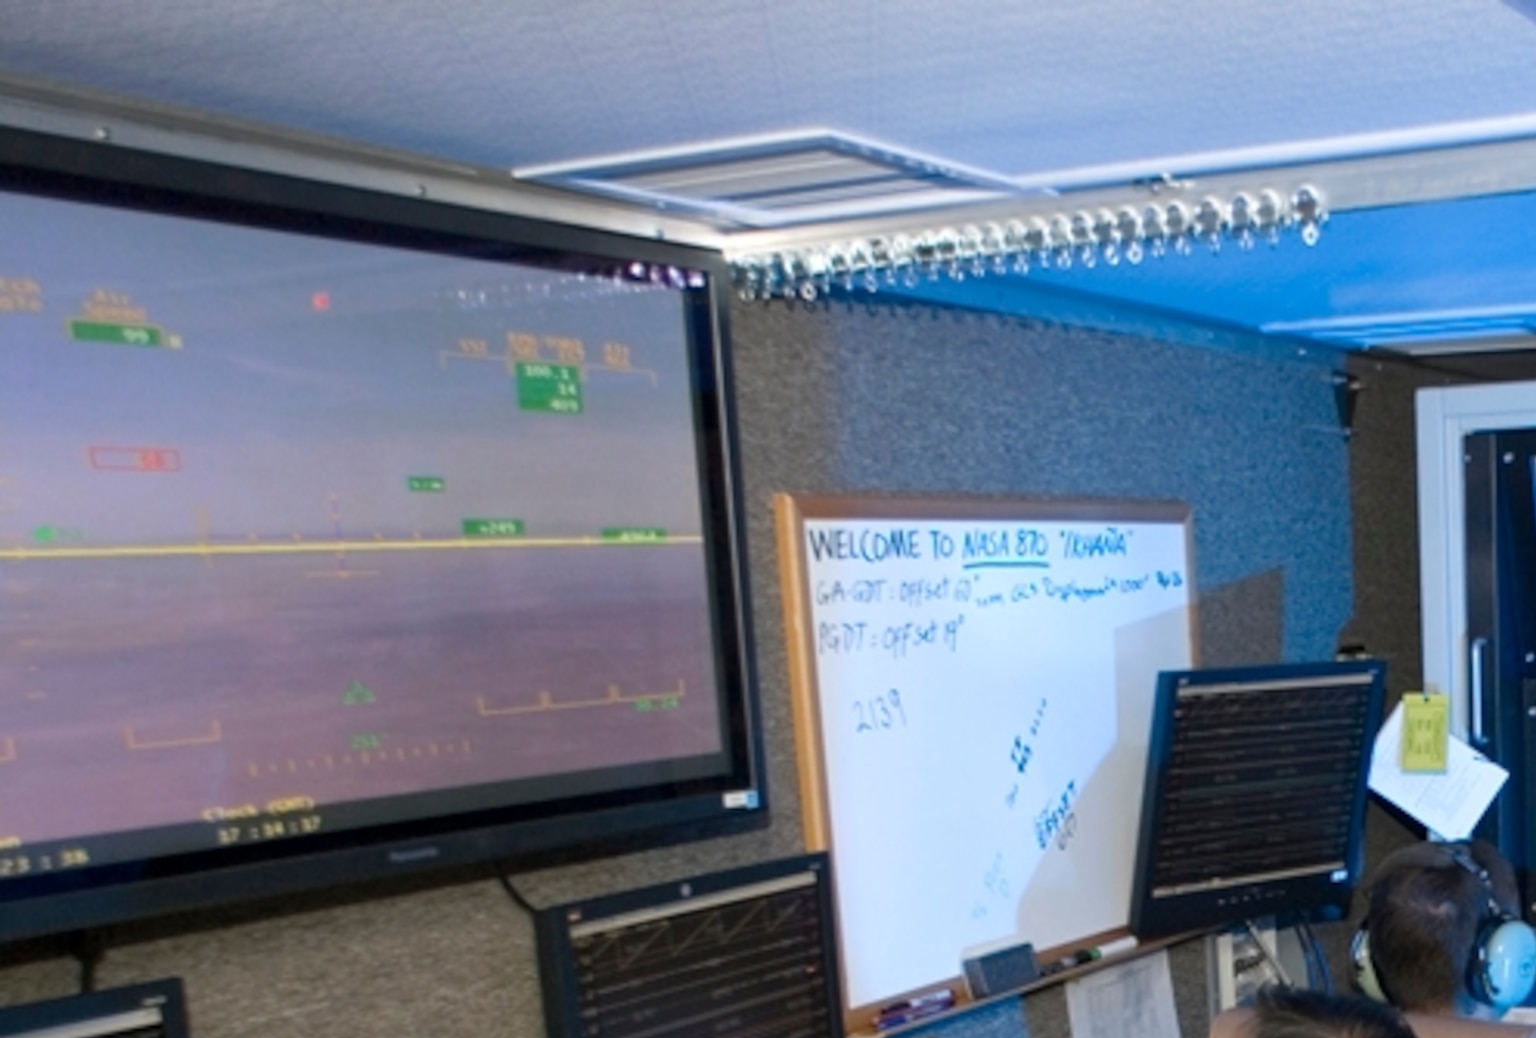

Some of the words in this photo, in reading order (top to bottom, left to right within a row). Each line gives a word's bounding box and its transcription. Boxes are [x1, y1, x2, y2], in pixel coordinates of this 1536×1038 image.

[809, 529, 922, 563] WELCOME
[928, 529, 954, 560] TO
[962, 529, 1009, 559] NASA
[1015, 529, 1049, 556] 870
[852, 687, 907, 733] 2139
